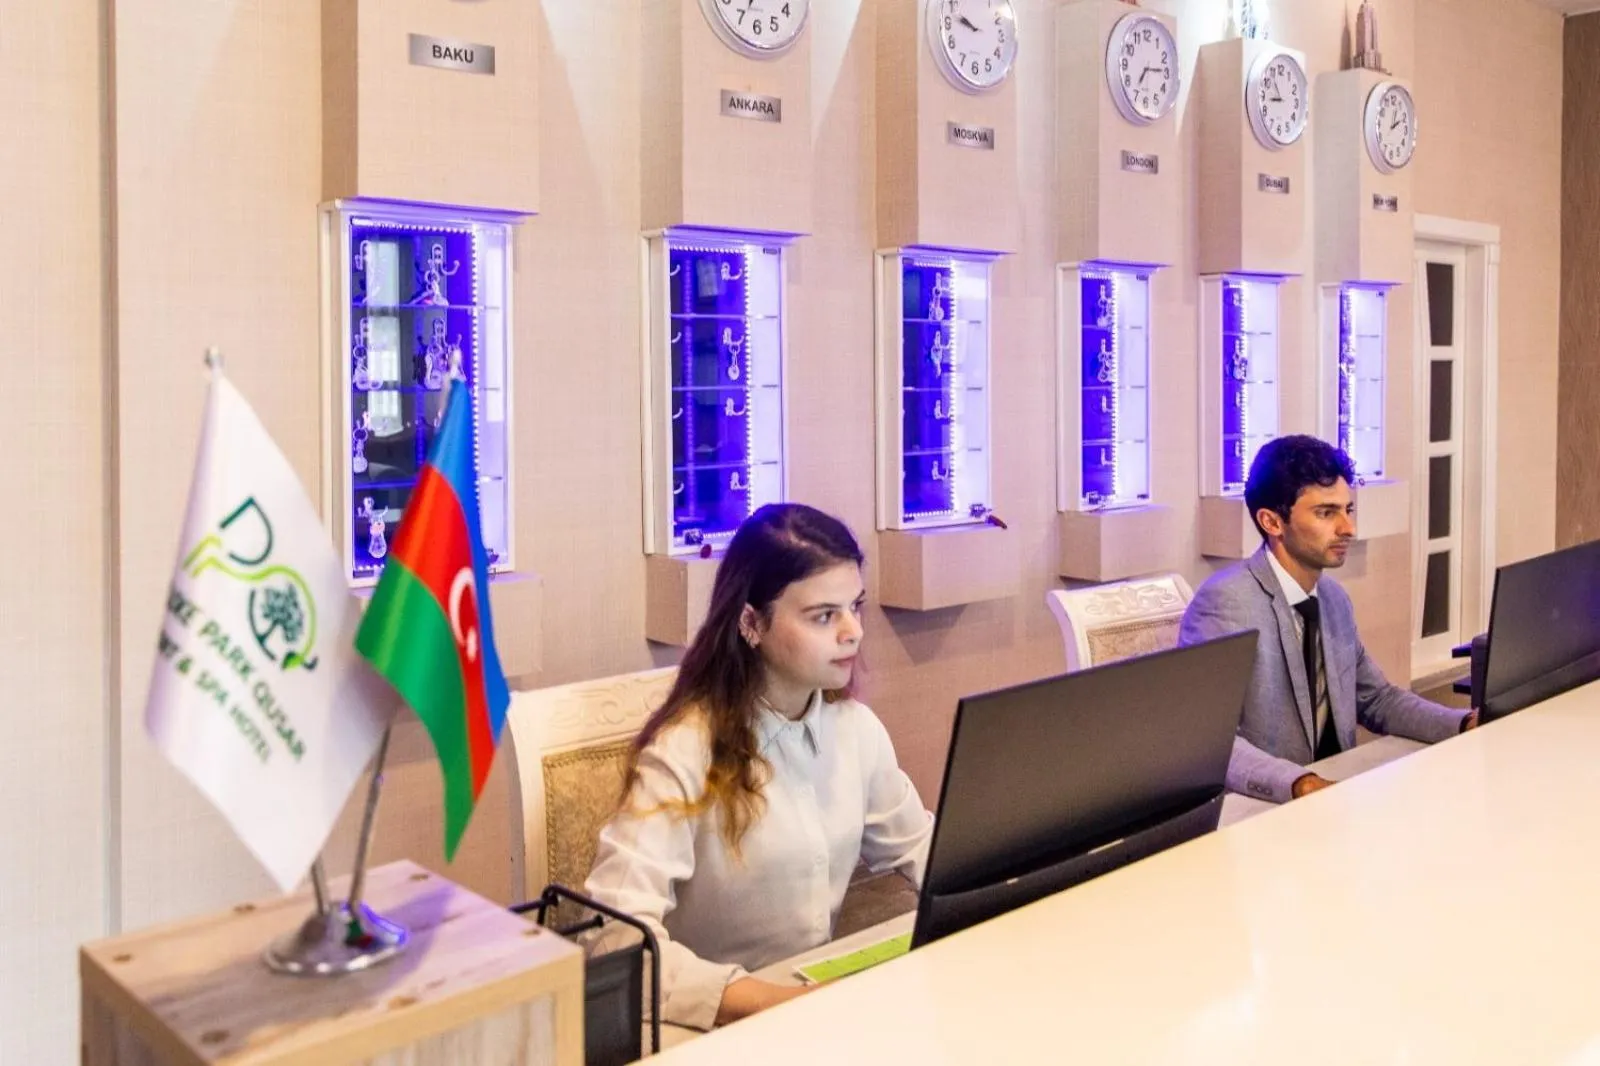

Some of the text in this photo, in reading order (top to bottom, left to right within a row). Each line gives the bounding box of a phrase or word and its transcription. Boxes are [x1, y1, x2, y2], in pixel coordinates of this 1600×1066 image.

[736, 8, 746, 25] 7
[781, 2, 791, 18] 4
[752, 19, 762, 35] 6
[769, 16, 779, 32] 5
[432, 44, 475, 64] BAKU
[728, 95, 774, 115] ANKARA
[953, 127, 989, 142] MOSKVA
[1126, 155, 1154, 169] LONDON
[198, 620, 253, 680] PARK
[253, 681, 305, 762] QUSAR
